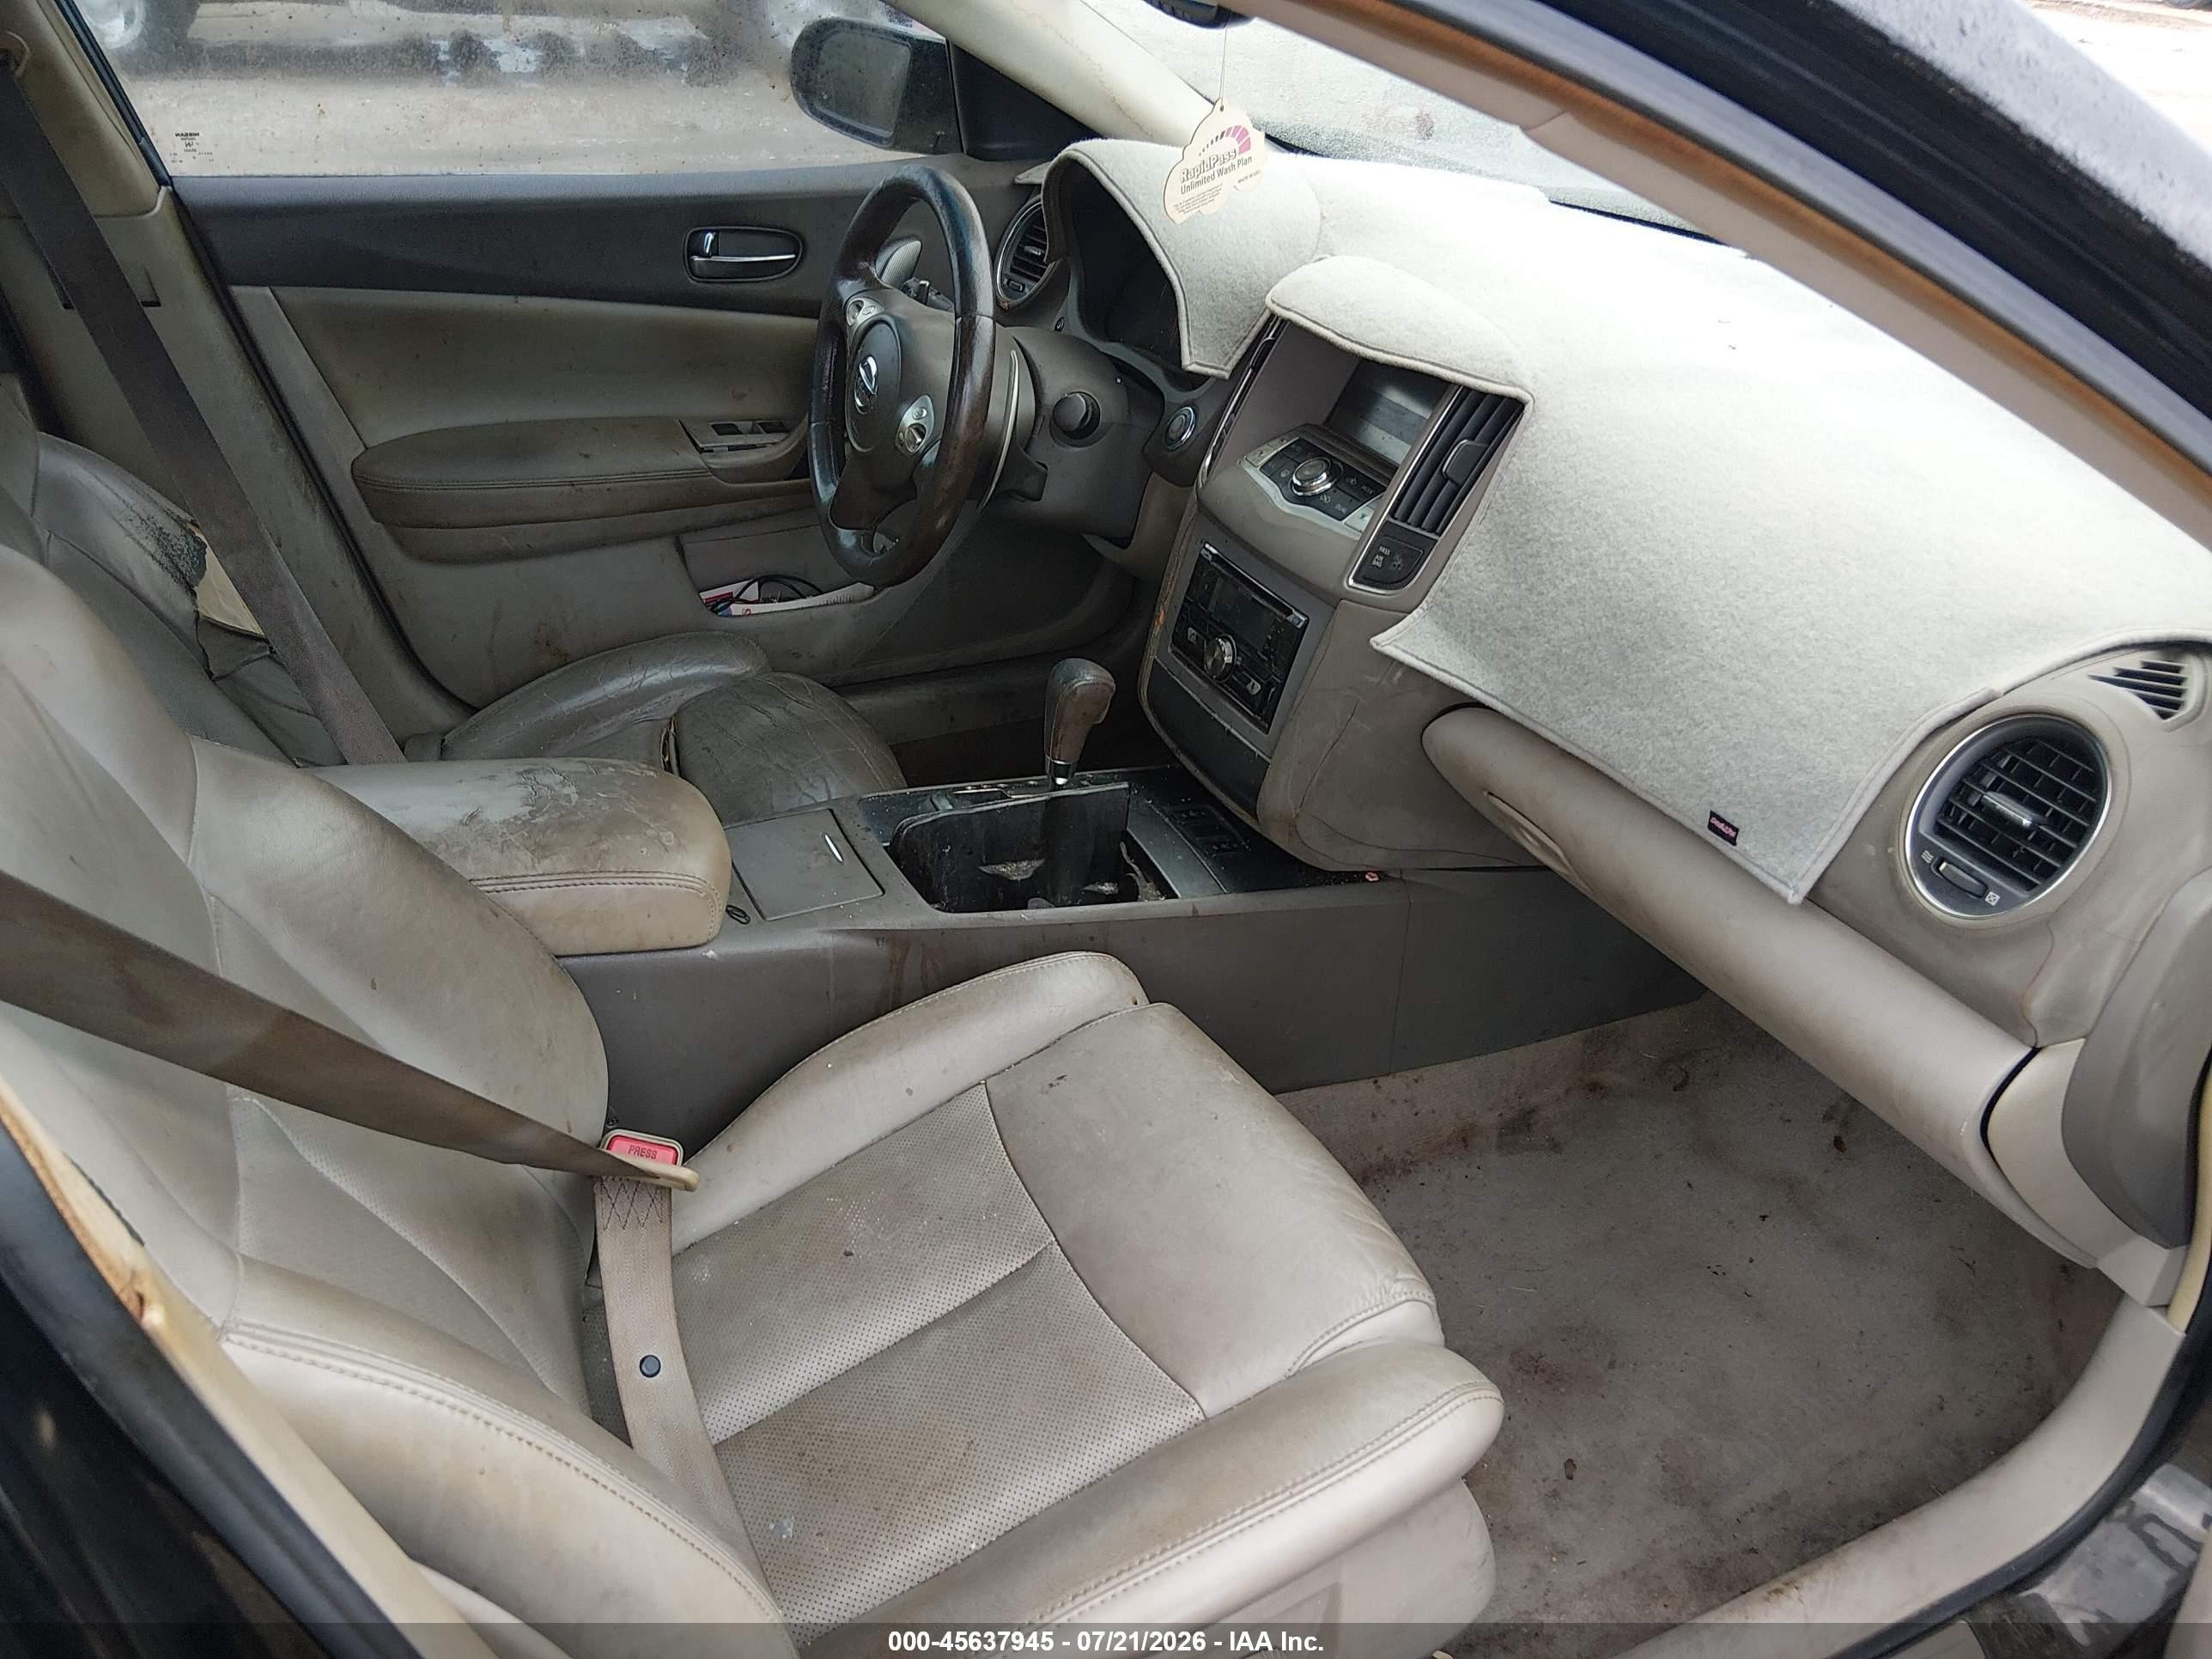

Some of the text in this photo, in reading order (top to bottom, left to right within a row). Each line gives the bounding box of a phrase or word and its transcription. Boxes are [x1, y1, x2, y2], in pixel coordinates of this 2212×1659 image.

[1180, 155, 1253, 195] Unlimited Wash Plan
[1181, 149, 1237, 183] RapidPass
[628, 1145, 658, 1160] PRESS
